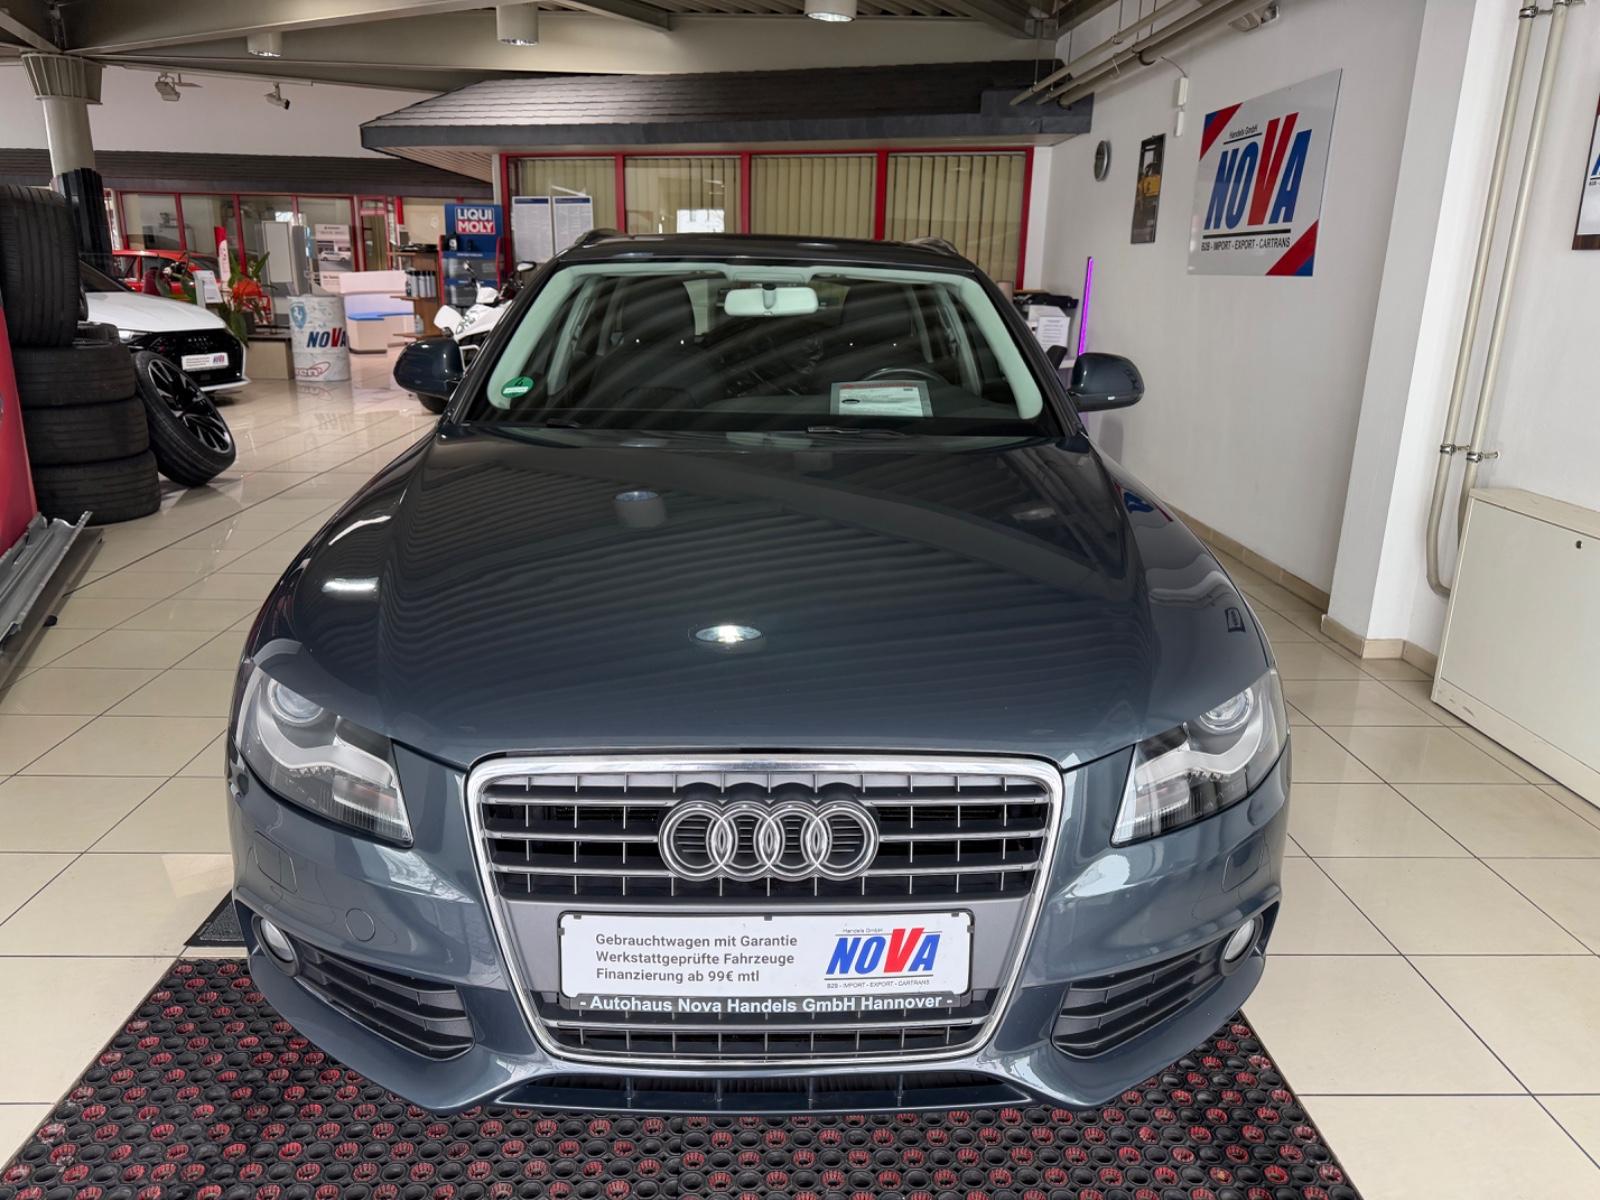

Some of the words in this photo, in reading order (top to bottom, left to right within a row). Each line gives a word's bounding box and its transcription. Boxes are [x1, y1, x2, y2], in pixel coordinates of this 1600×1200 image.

[1204, 112, 1312, 230] NOVA
[457, 208, 493, 220] LIQUI
[458, 221, 494, 233] MOLY
[1213, 240, 1232, 250] IMPORT
[1234, 239, 1256, 250] EXPORT
[1259, 237, 1291, 248] CARTRANS
[306, 327, 346, 348] NOVA
[595, 933, 710, 950] Gebrauchtwagen
[714, 935, 737, 947] mit
[740, 935, 798, 947] Garantie
[596, 950, 720, 967] Werkstattgeprüfte
[724, 952, 795, 967] Fahrzeuge
[825, 927, 941, 975] NOVA
[596, 968, 684, 985] Finanzierung
[687, 970, 704, 982] ab
[708, 970, 734, 982] 99€
[737, 970, 760, 982] mtl
[869, 980, 894, 988] EXPORT
[590, 995, 673, 1012] Autohaus
[678, 998, 721, 1012] Nova
[727, 998, 798, 1013] Handels
[802, 997, 856, 1012] GmbH
[861, 996, 943, 1011] Hannover
